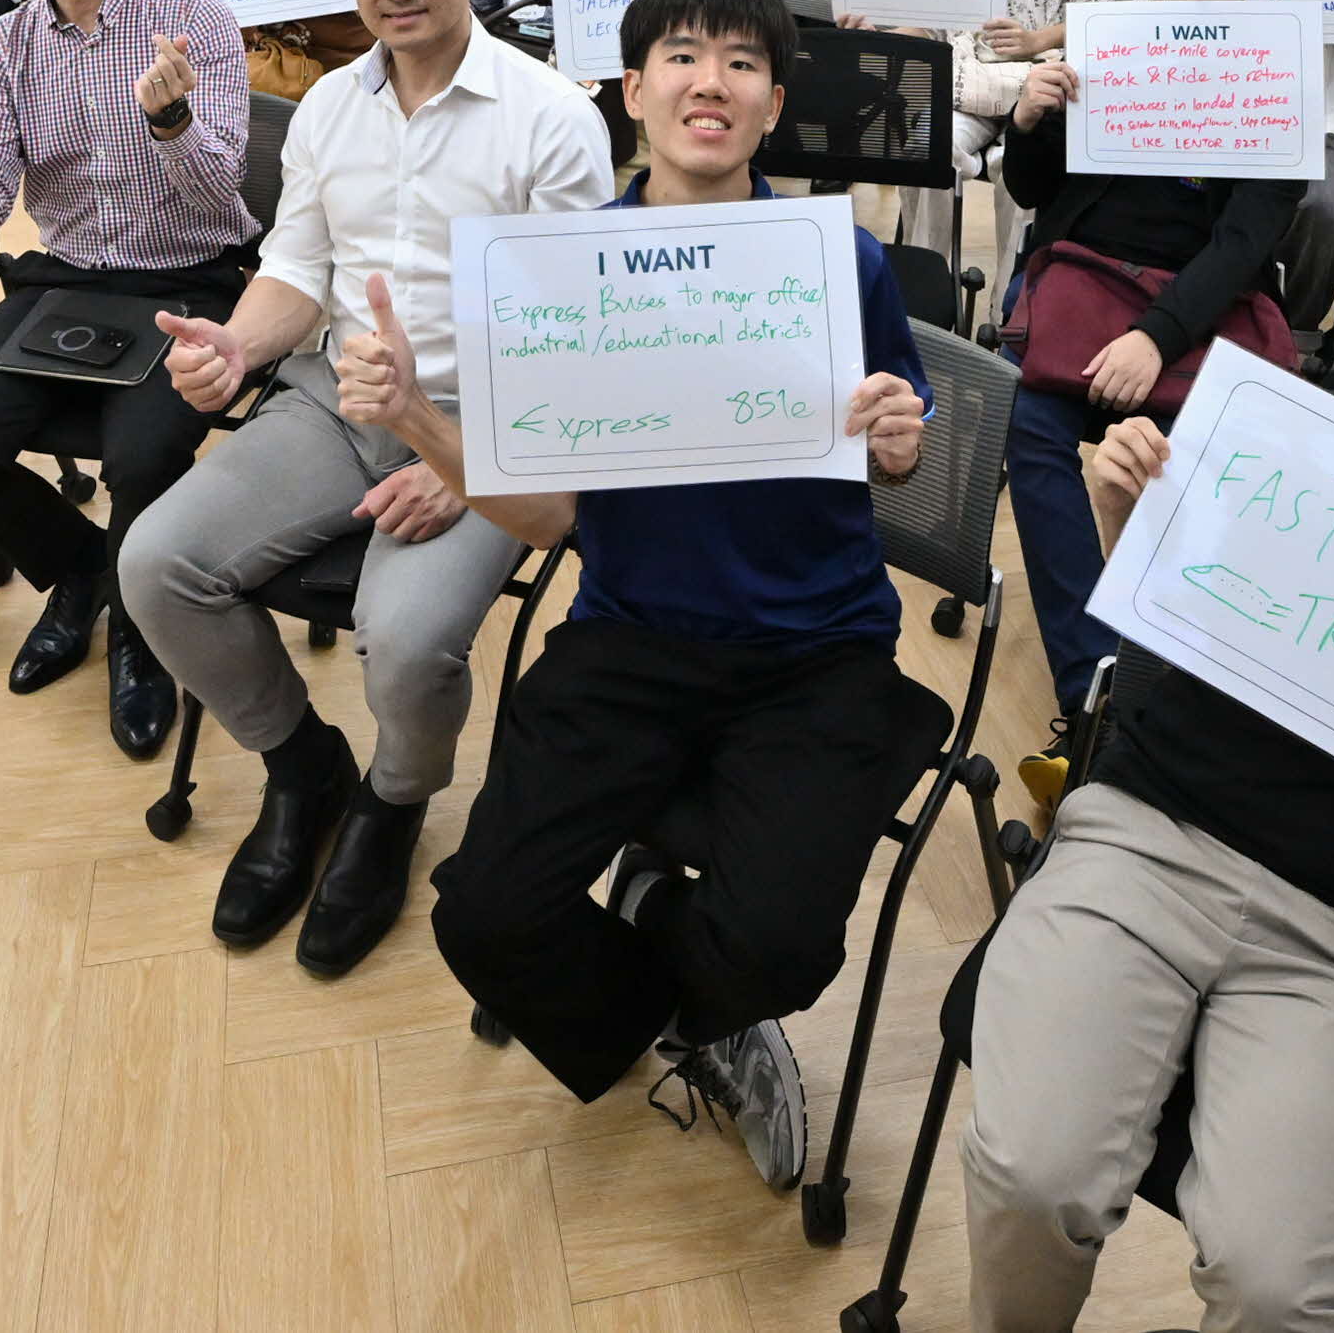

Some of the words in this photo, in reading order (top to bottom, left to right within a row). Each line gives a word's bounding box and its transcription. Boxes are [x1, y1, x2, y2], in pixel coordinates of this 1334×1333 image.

[1156, 26, 1160, 40] I
[1172, 26, 1230, 40] WANT
[1146, 42, 1208, 58] last-mile
[1216, 46, 1271, 64] coverage
[1103, 71, 1140, 87] Park
[1167, 67, 1211, 85] Ride
[1219, 71, 1240, 82] to
[1246, 71, 1296, 83] return
[1104, 101, 1166, 116] minibuses
[1174, 99, 1186, 111] in
[1192, 92, 1235, 111] landed
[1242, 95, 1289, 108] estates
[1132, 137, 1164, 148] LIKE
[1175, 137, 1222, 149] LENTOR
[598, 252, 605, 277] I
[624, 245, 716, 275] WANT
[493, 294, 587, 325] Express
[599, 283, 666, 319] Buses
[677, 281, 703, 306] to
[713, 286, 756, 313] major
[736, 315, 812, 342] districts
[511, 403, 672, 452] Express
